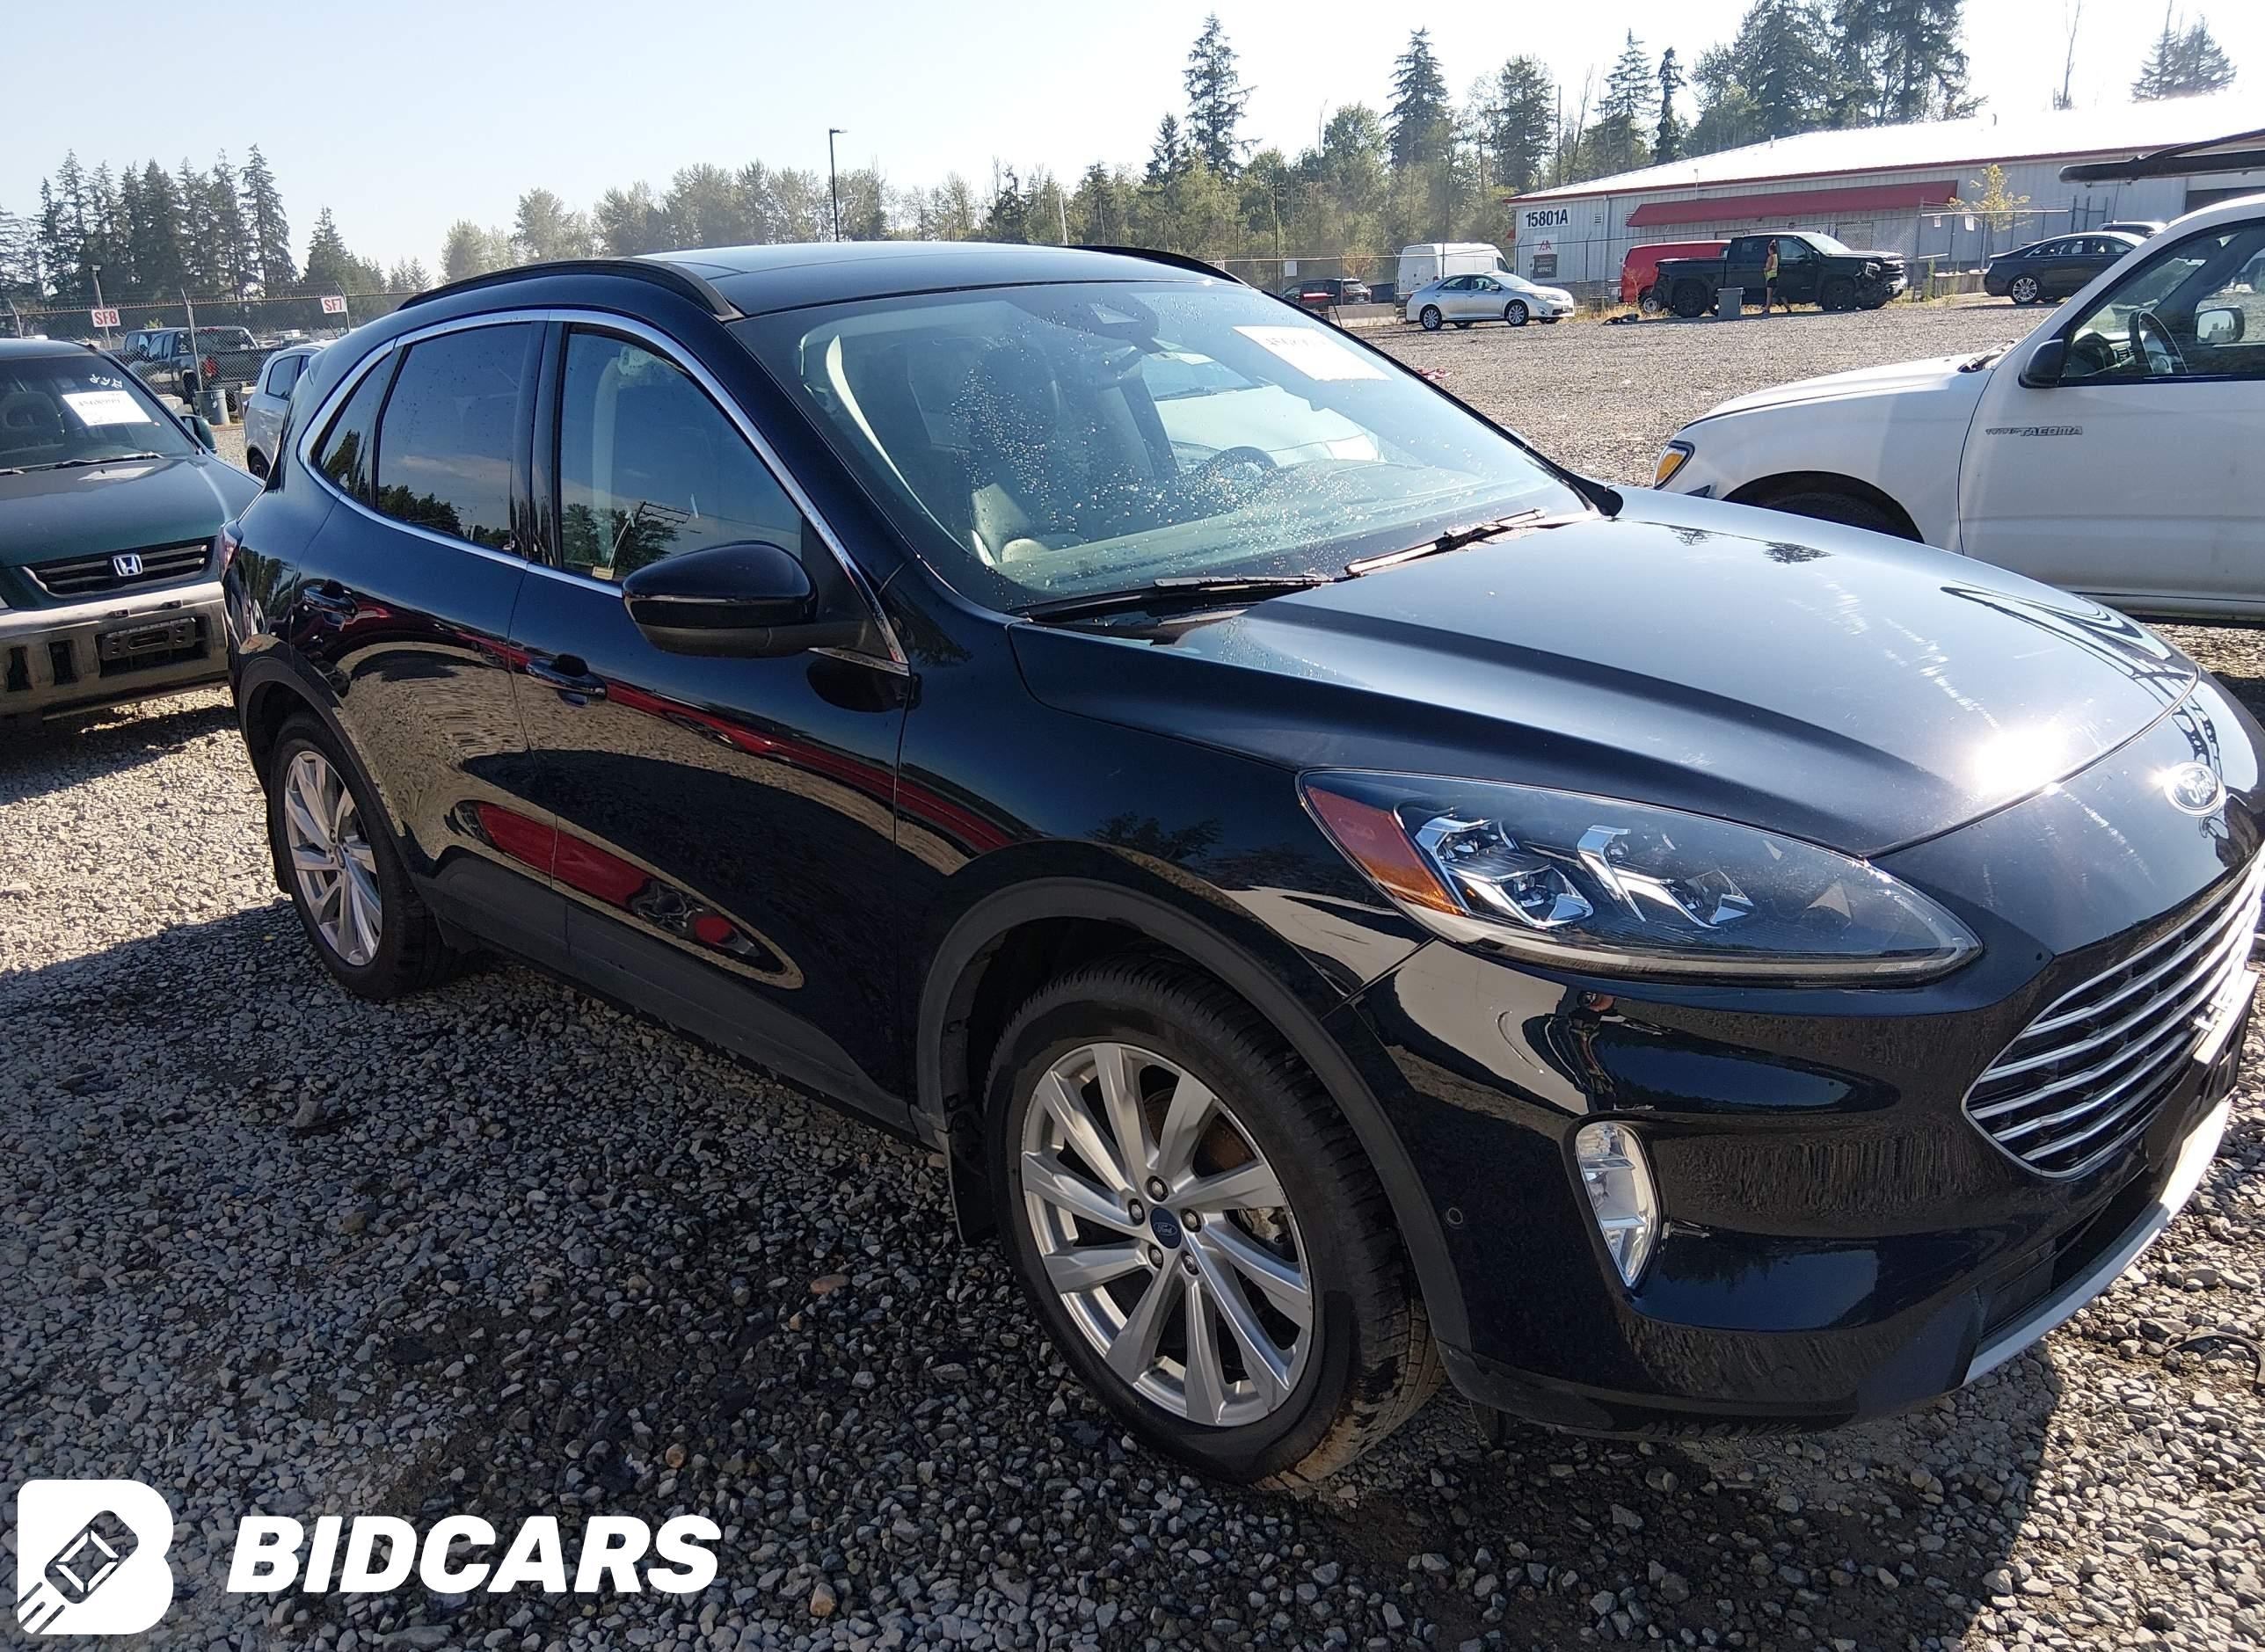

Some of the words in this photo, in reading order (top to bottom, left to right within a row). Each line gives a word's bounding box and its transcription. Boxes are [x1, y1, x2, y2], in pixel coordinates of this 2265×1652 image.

[1526, 208, 1569, 228] 15801A
[324, 298, 342, 312] SF7
[94, 310, 118, 325] SF8
[2020, 426, 2083, 437] TACOMA
